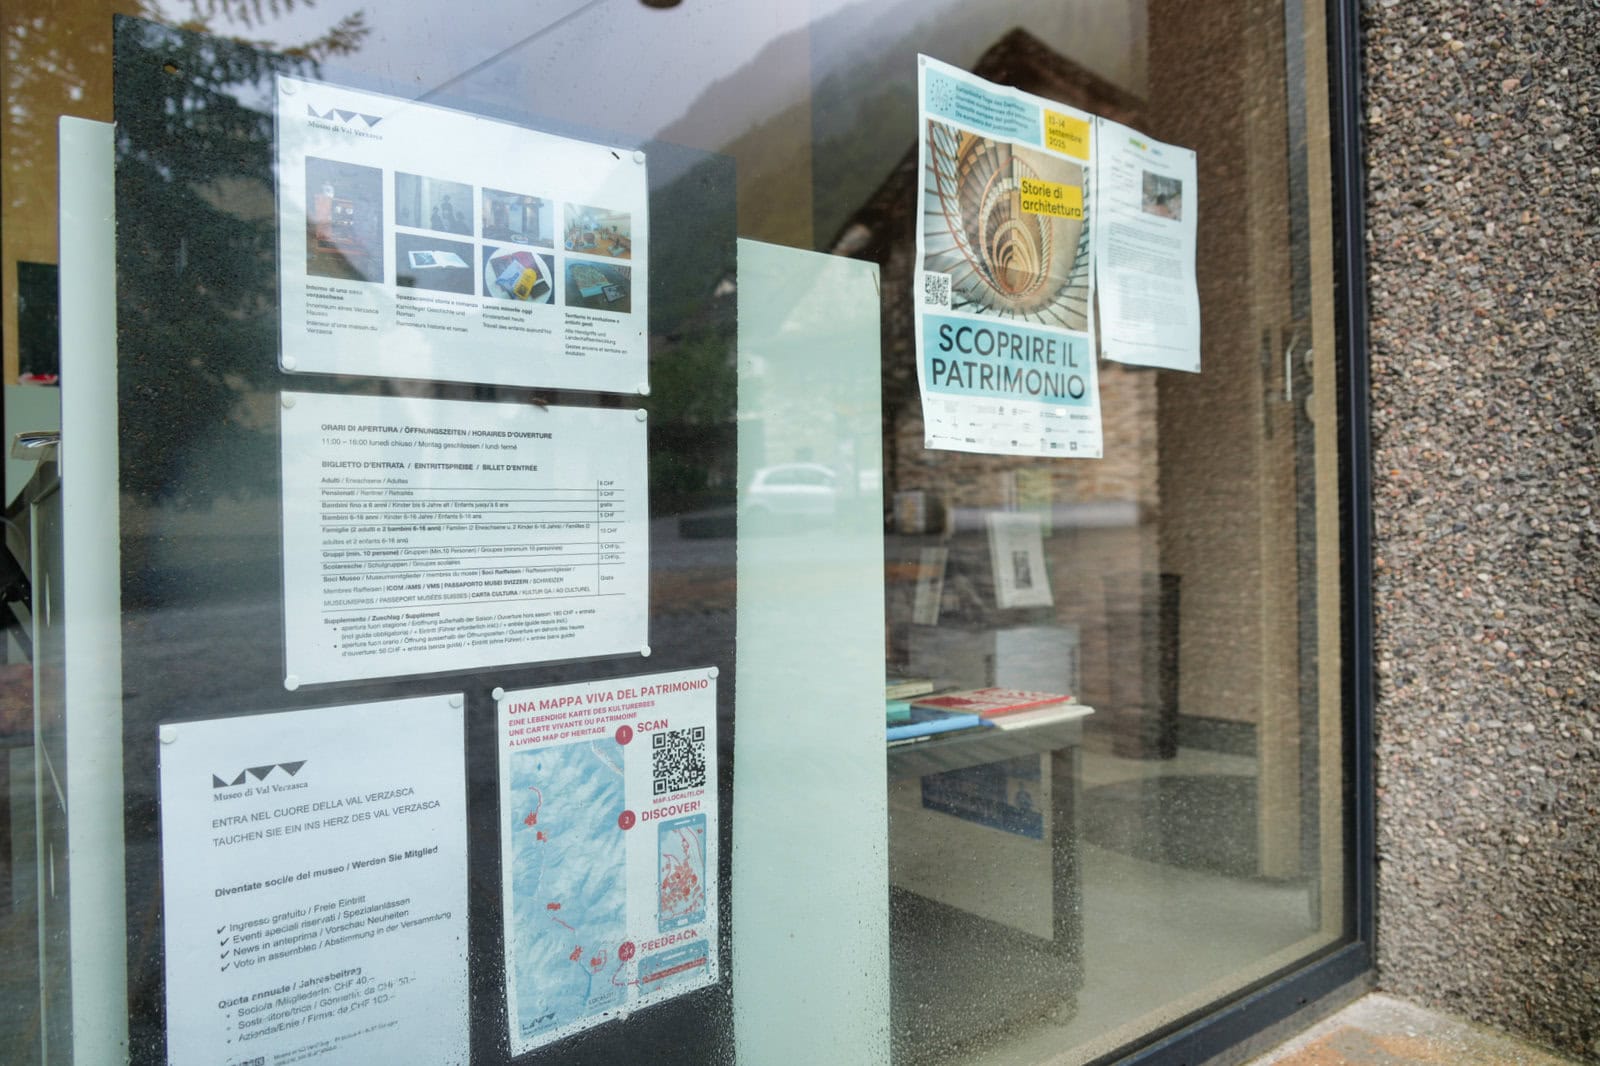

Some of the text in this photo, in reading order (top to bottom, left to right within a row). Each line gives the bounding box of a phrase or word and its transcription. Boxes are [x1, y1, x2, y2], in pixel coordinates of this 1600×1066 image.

[1049, 137, 1066, 149] 2025
[1022, 181, 1063, 199] Storie di
[1022, 199, 1081, 217] architettura
[939, 323, 1078, 368] SCOPRIRE IL
[931, 358, 1085, 400] PATRIMONIO
[320, 423, 346, 431] ORARI
[404, 426, 466, 435] ÖFFNUNGSZEITEN
[321, 460, 362, 468] BIGLIETTO
[508, 678, 708, 714] UNA MAPPA VIVA DEL PATRIMONIO
[508, 717, 525, 726] EINE
[526, 712, 567, 724] LEBENDIGE
[568, 708, 592, 718] KARTE
[592, 706, 607, 714] DES
[508, 727, 524, 736] UNE
[525, 724, 550, 733] CARTE
[551, 719, 583, 729] VIVANTE
[595, 711, 637, 723] PATRIMOINE
[637, 719, 668, 733] SCAN
[515, 735, 541, 745] LIVING
[541, 733, 558, 741] MAP
[559, 731, 569, 739] OF
[570, 726, 606, 737] HERITAGE
[213, 780, 308, 801] Museo di Val Verzasca
[211, 786, 414, 828] ENTRA NEL CUORE DELLA VAL VERZASCA
[641, 800, 701, 822] DISCOVER!
[212, 799, 440, 847] TAUCHEN SIE EIN INS HERZ DES VAL VERZASCA
[214, 845, 438, 897] Diventate soci/e del museo Werden Sie Mitglied
[229, 894, 365, 933] Ingresso gratuito Freie Eintritt
[232, 896, 410, 944] Eventi speciali riservati Spezialanlässen
[233, 908, 409, 956] News in anteprima Vorschau Neuheiten
[233, 956, 254, 969] Voto
[257, 955, 265, 963] in
[324, 929, 374, 947] Abstimmung
[376, 926, 384, 934] in
[385, 923, 398, 932] der
[400, 910, 451, 929] Versammlung
[641, 929, 698, 953] FEEDBACK
